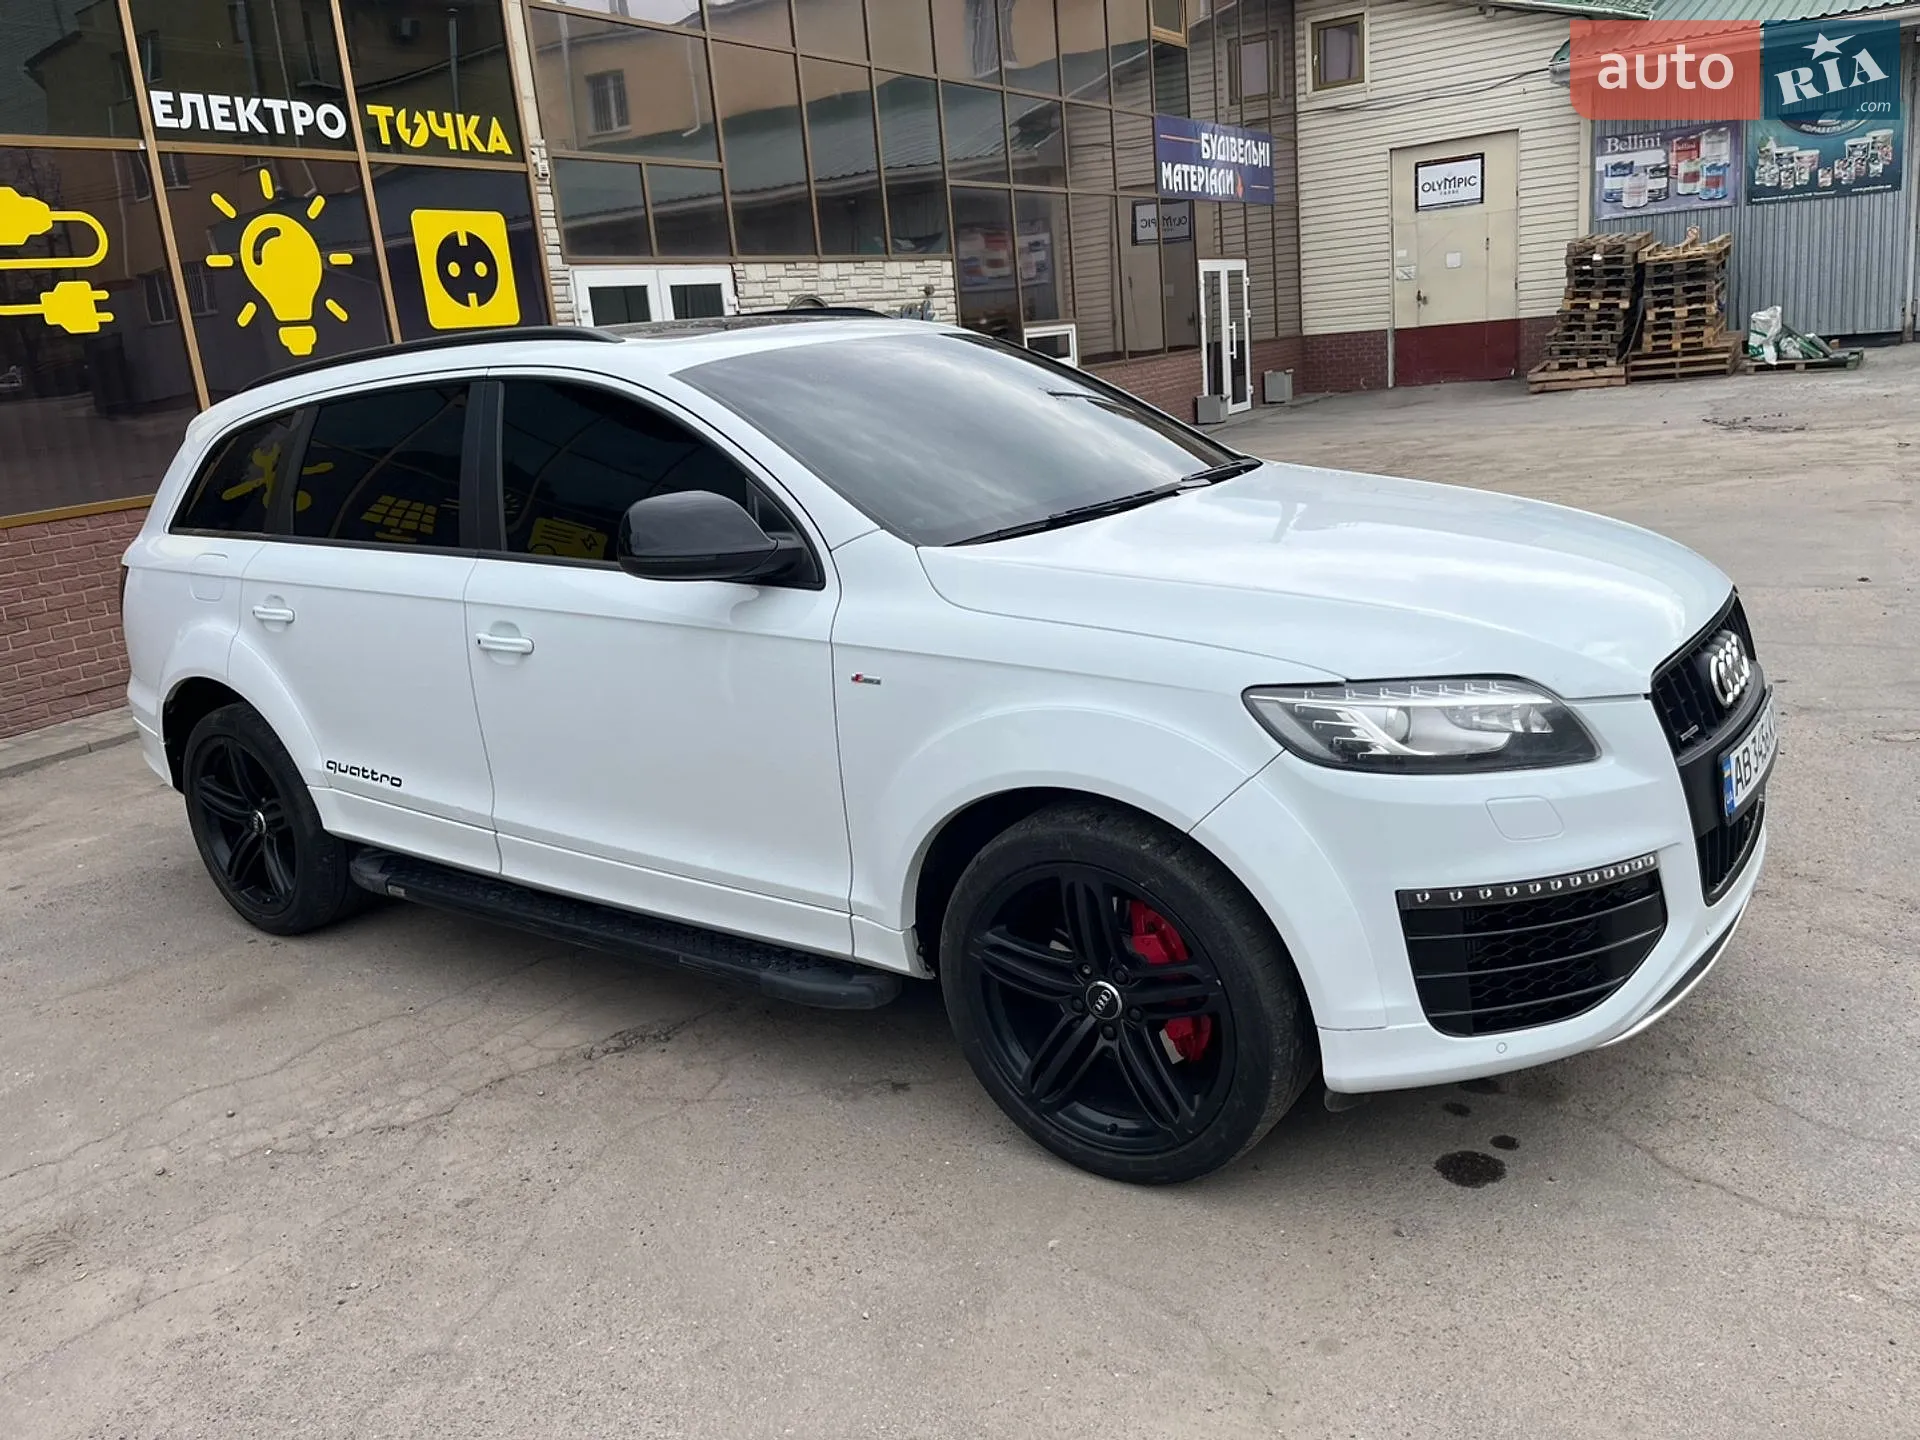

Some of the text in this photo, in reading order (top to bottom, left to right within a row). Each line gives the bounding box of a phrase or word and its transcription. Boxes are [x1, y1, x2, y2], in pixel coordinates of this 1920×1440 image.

[150, 90, 513, 155] ЕЛЕКТРО ТОЧКА
[1201, 132, 1270, 168] БУДІВЕЛЬНІ
[1606, 132, 1662, 153] Bellini
[1161, 161, 1235, 196] МАТЕРІАЛИ
[1421, 174, 1477, 193] OLYMPIC
[326, 760, 403, 788] quattro
